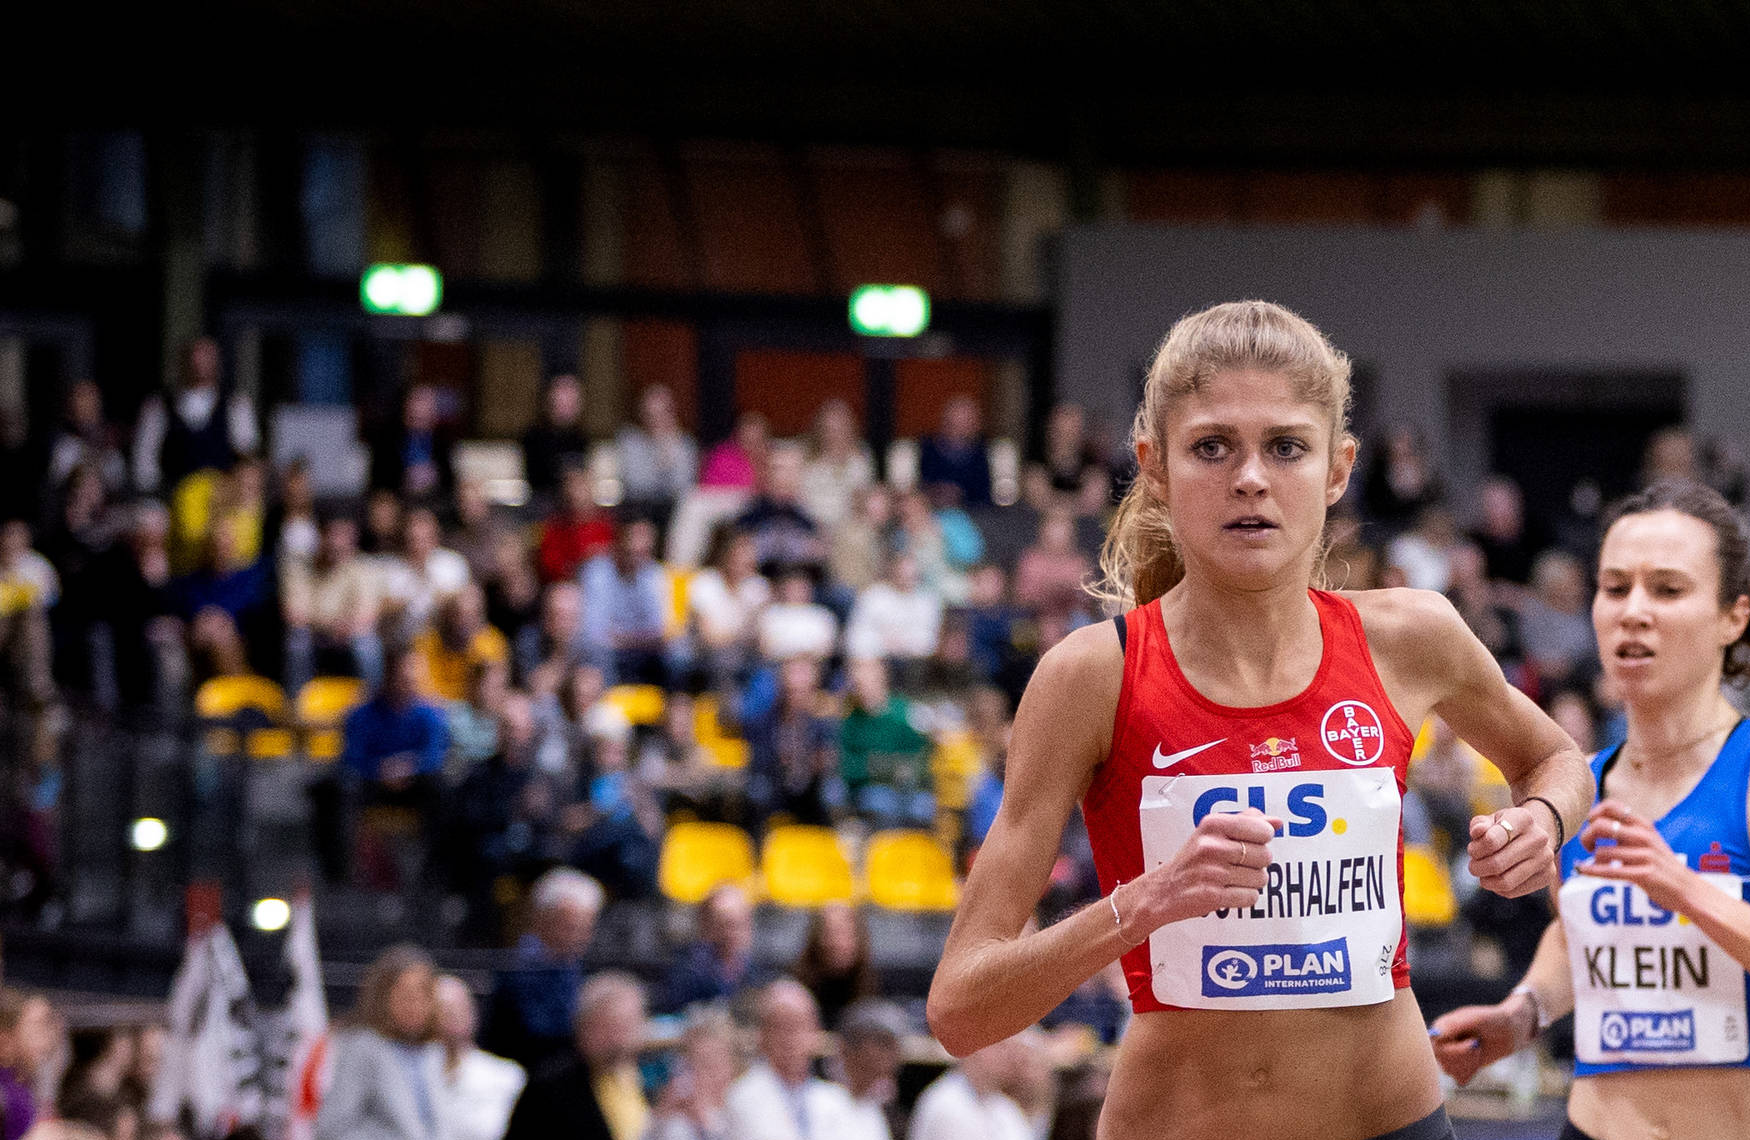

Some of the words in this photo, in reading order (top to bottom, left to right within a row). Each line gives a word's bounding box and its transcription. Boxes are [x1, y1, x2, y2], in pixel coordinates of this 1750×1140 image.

[1327, 726, 1379, 742] BAYER
[1344, 706, 1366, 760] BAYER
[1252, 756, 1279, 773] Red
[1279, 752, 1301, 769] Bull
[1263, 950, 1345, 977] PLAN
[1584, 945, 1710, 990] KLEIN
[1264, 976, 1346, 989] INTERNATIONAL
[1631, 1016, 1692, 1038] PLAN
